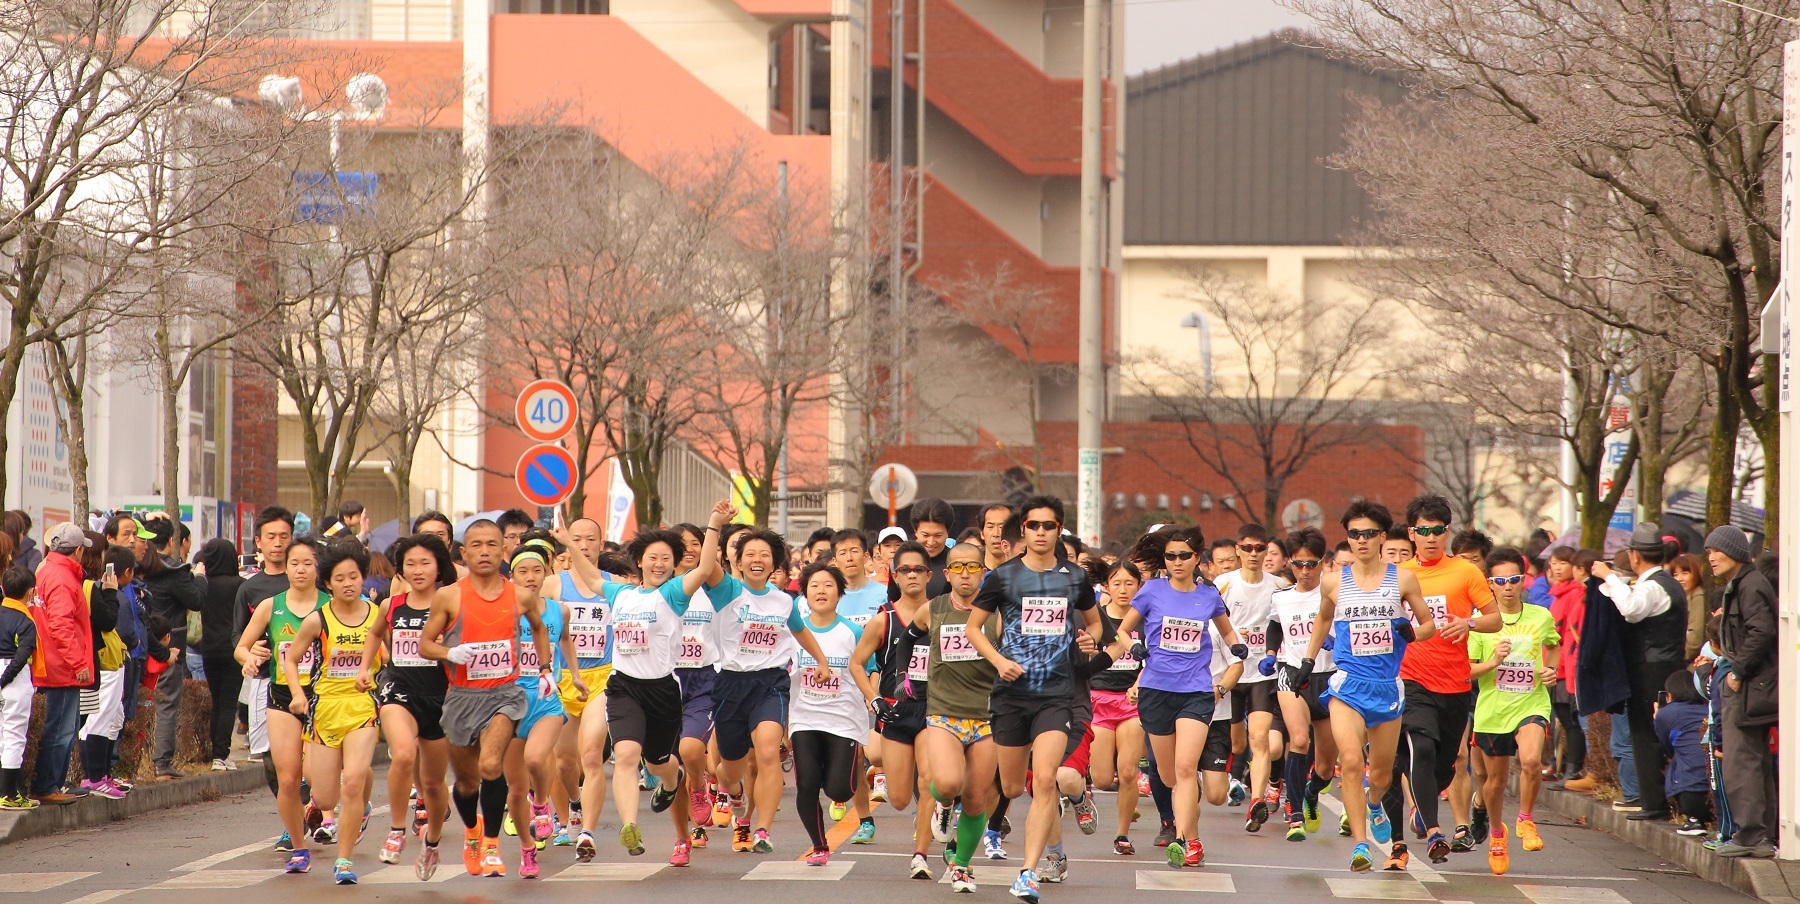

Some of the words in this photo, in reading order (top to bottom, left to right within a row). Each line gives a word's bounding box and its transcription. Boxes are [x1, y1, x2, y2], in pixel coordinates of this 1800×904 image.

[1781, 151, 1793, 402] スタート地点
[531, 397, 564, 424] 40
[1024, 609, 1065, 624] 7234
[1408, 605, 1446, 622] 75
[749, 622, 775, 631] きりしん
[1168, 618, 1199, 627] 桐生ガス
[1289, 621, 1314, 637] 610
[335, 632, 368, 646] 桐生
[399, 631, 420, 639] きりし
[570, 634, 605, 648] 7314
[615, 630, 645, 644] 10041
[742, 631, 778, 646] 10045
[1162, 627, 1200, 643] 8167
[1352, 630, 1391, 646] 7364
[395, 640, 419, 656] 100
[942, 636, 972, 650] 732
[331, 656, 362, 668] 1000
[469, 651, 511, 669] 7404
[908, 656, 927, 670] 31
[1497, 669, 1534, 683] 7395
